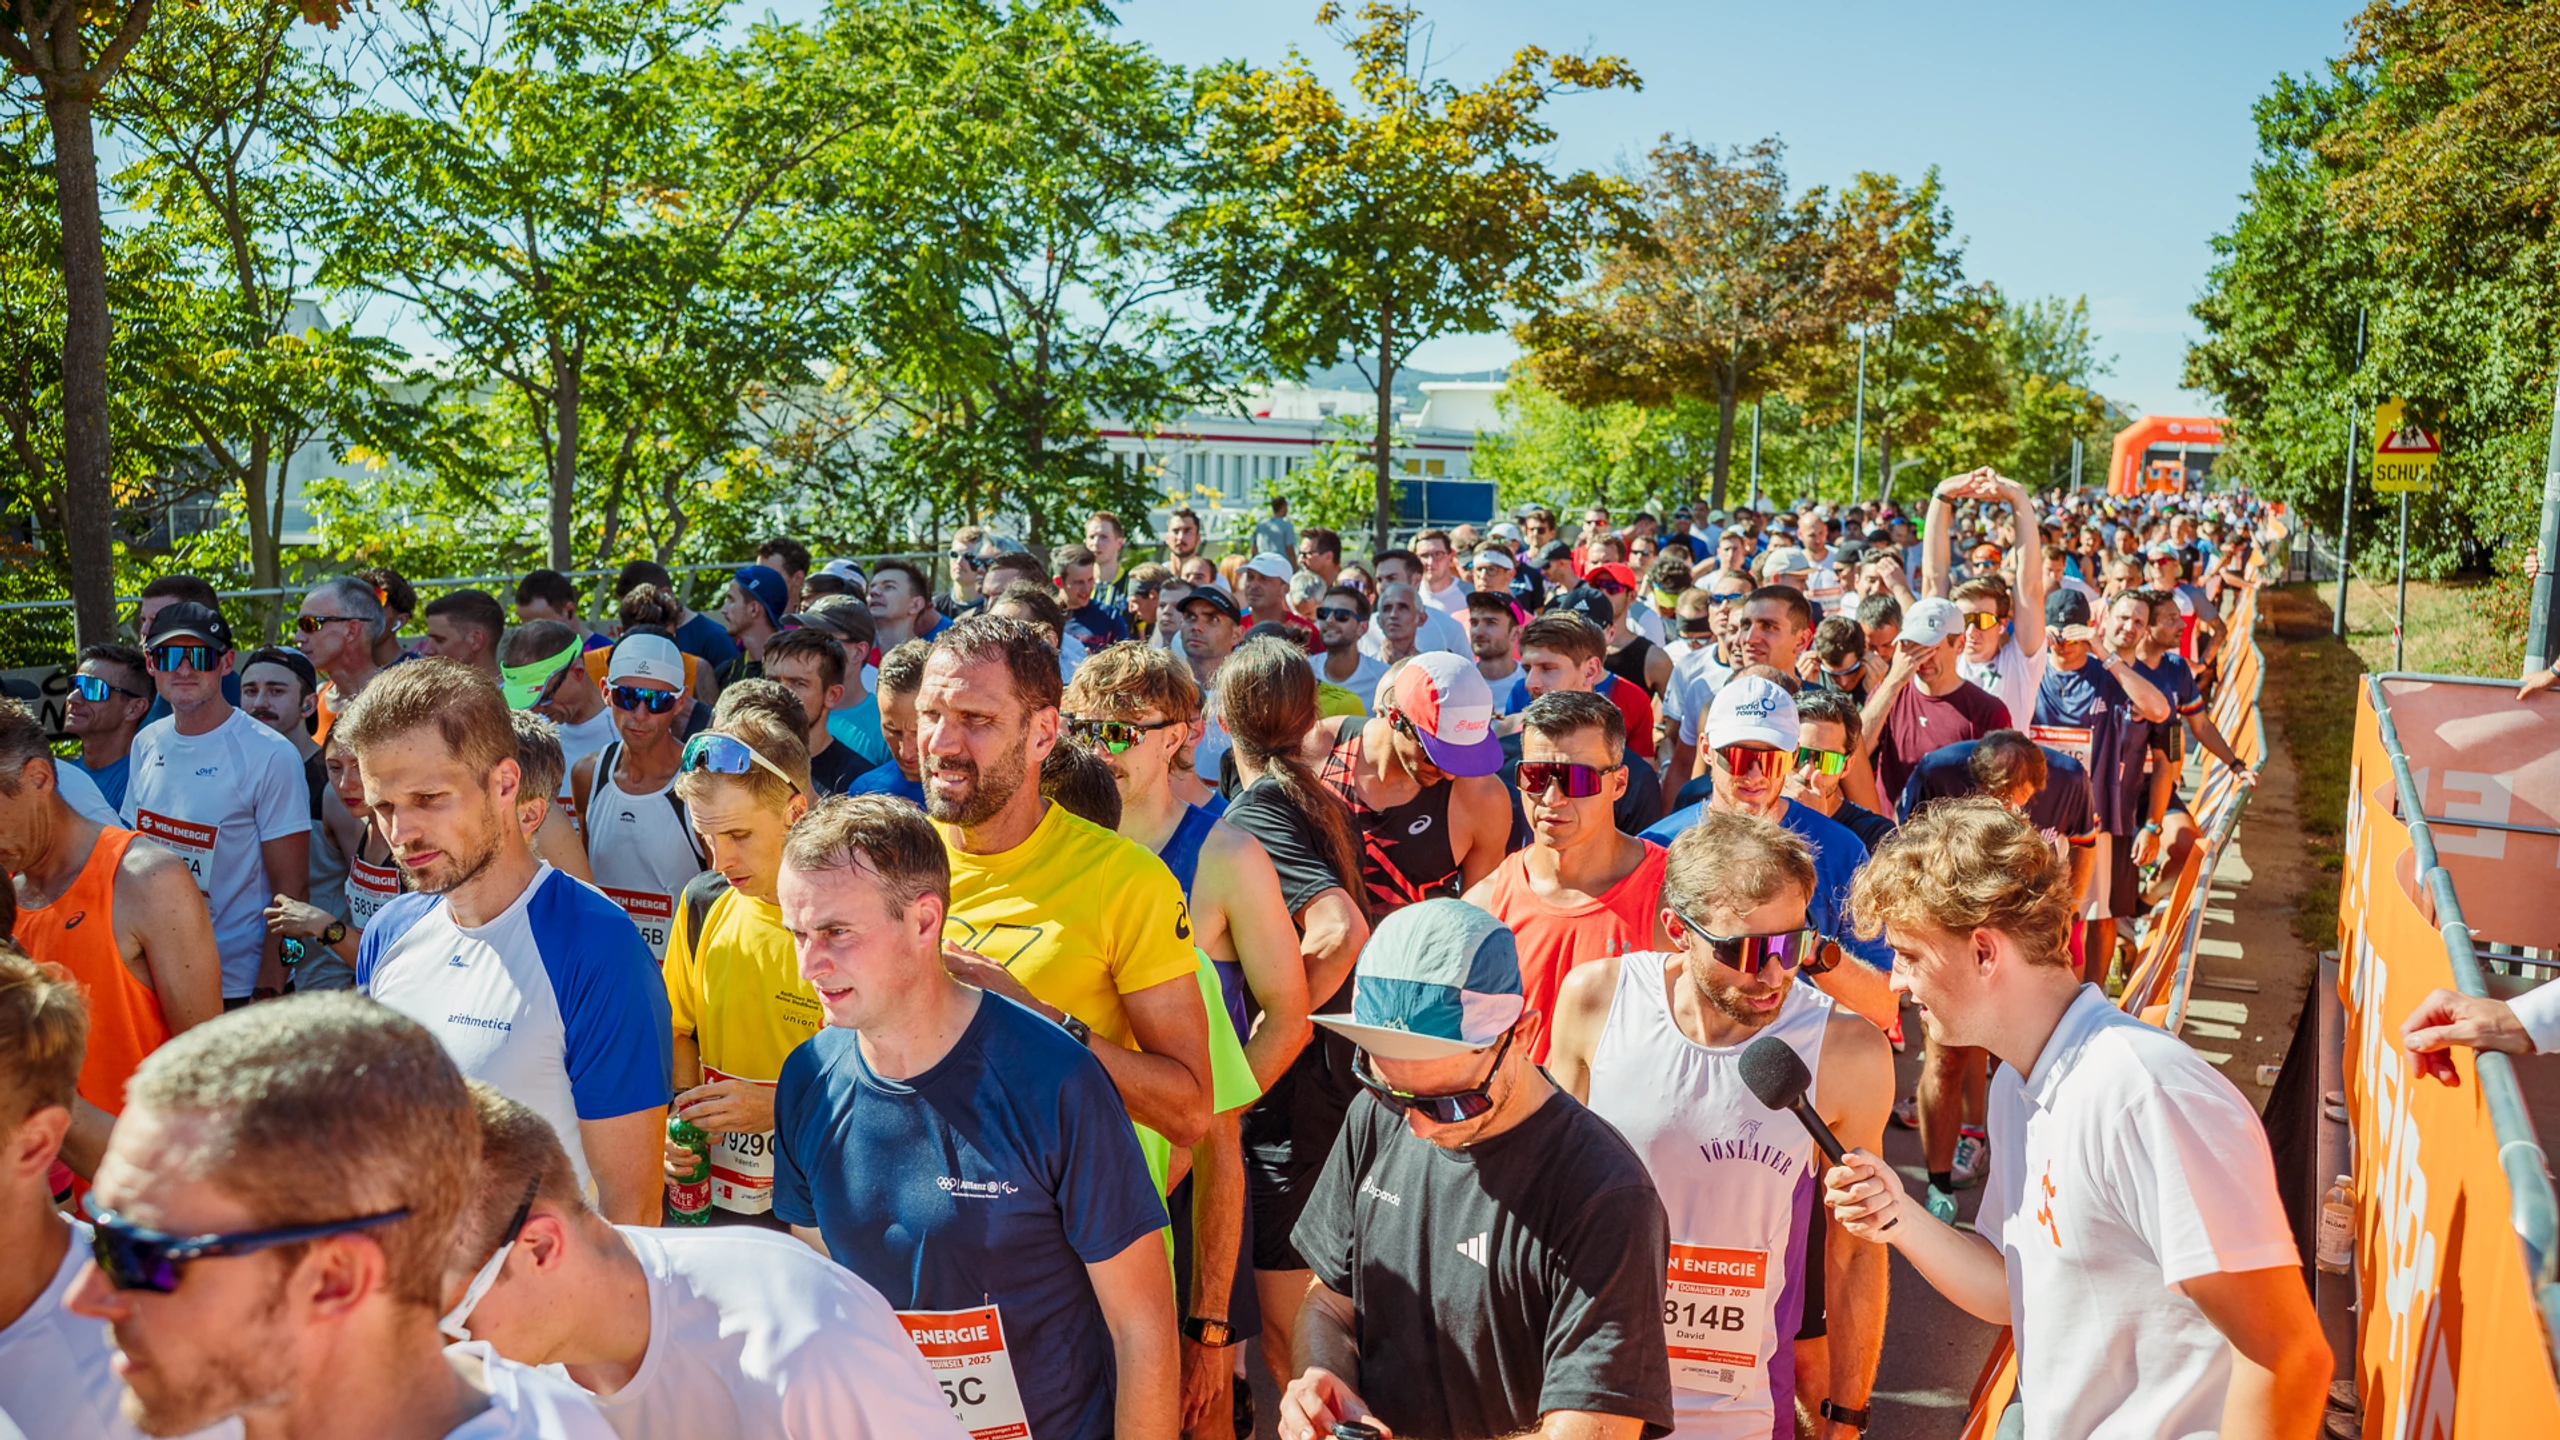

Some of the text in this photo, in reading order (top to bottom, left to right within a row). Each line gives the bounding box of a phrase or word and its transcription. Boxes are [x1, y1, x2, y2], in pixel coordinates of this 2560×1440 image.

[2376, 463, 2440, 482] SCHU
[1735, 699, 1760, 711] world
[1736, 710, 1768, 719] rowing
[154, 820, 173, 834] WIEN
[173, 826, 211, 843] ENERGIE
[364, 872, 397, 887] ENERGIE
[354, 896, 385, 917] 5835
[611, 894, 668, 912] IEN ENERGIE
[640, 927, 664, 946] 5B
[447, 1013, 512, 1031] arithmetica
[782, 1014, 815, 1028] union
[733, 1155, 760, 1169] Valentin
[1699, 1137, 1793, 1176] VÖSLAUER
[960, 1180, 987, 1191] Allianz
[2325, 1218, 2347, 1230] RELOAD
[1683, 1258, 1756, 1277] ENERGIE
[1679, 1284, 1725, 1297] DONAUINSEL
[1729, 1288, 1751, 1298] 2025
[911, 1325, 990, 1345] ENERGIE
[1676, 1330, 1705, 1340] David
[968, 1355, 992, 1366] 2025
[970, 1427, 1012, 1438] ersicherungen
